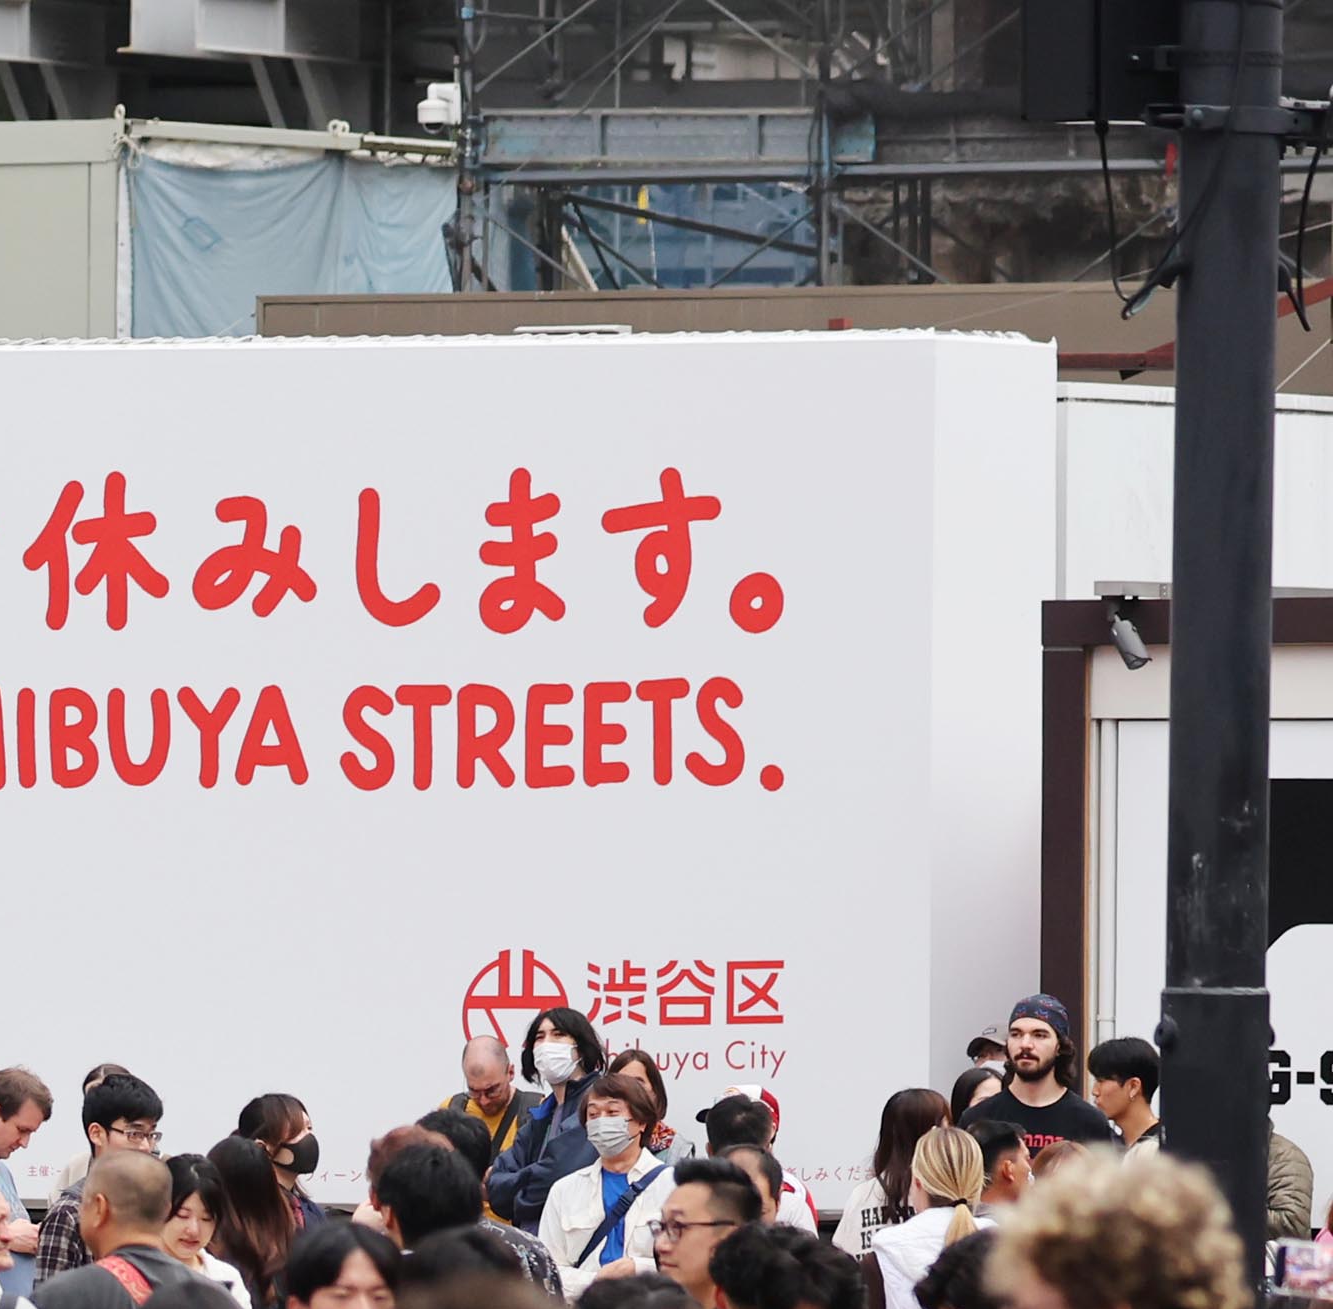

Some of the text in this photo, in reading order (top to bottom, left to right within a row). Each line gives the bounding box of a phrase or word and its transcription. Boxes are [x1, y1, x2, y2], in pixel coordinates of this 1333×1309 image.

[341, 676, 784, 791] STREETS.
[587, 960, 785, 1025] 渋谷区
[725, 1041, 786, 1079] City
